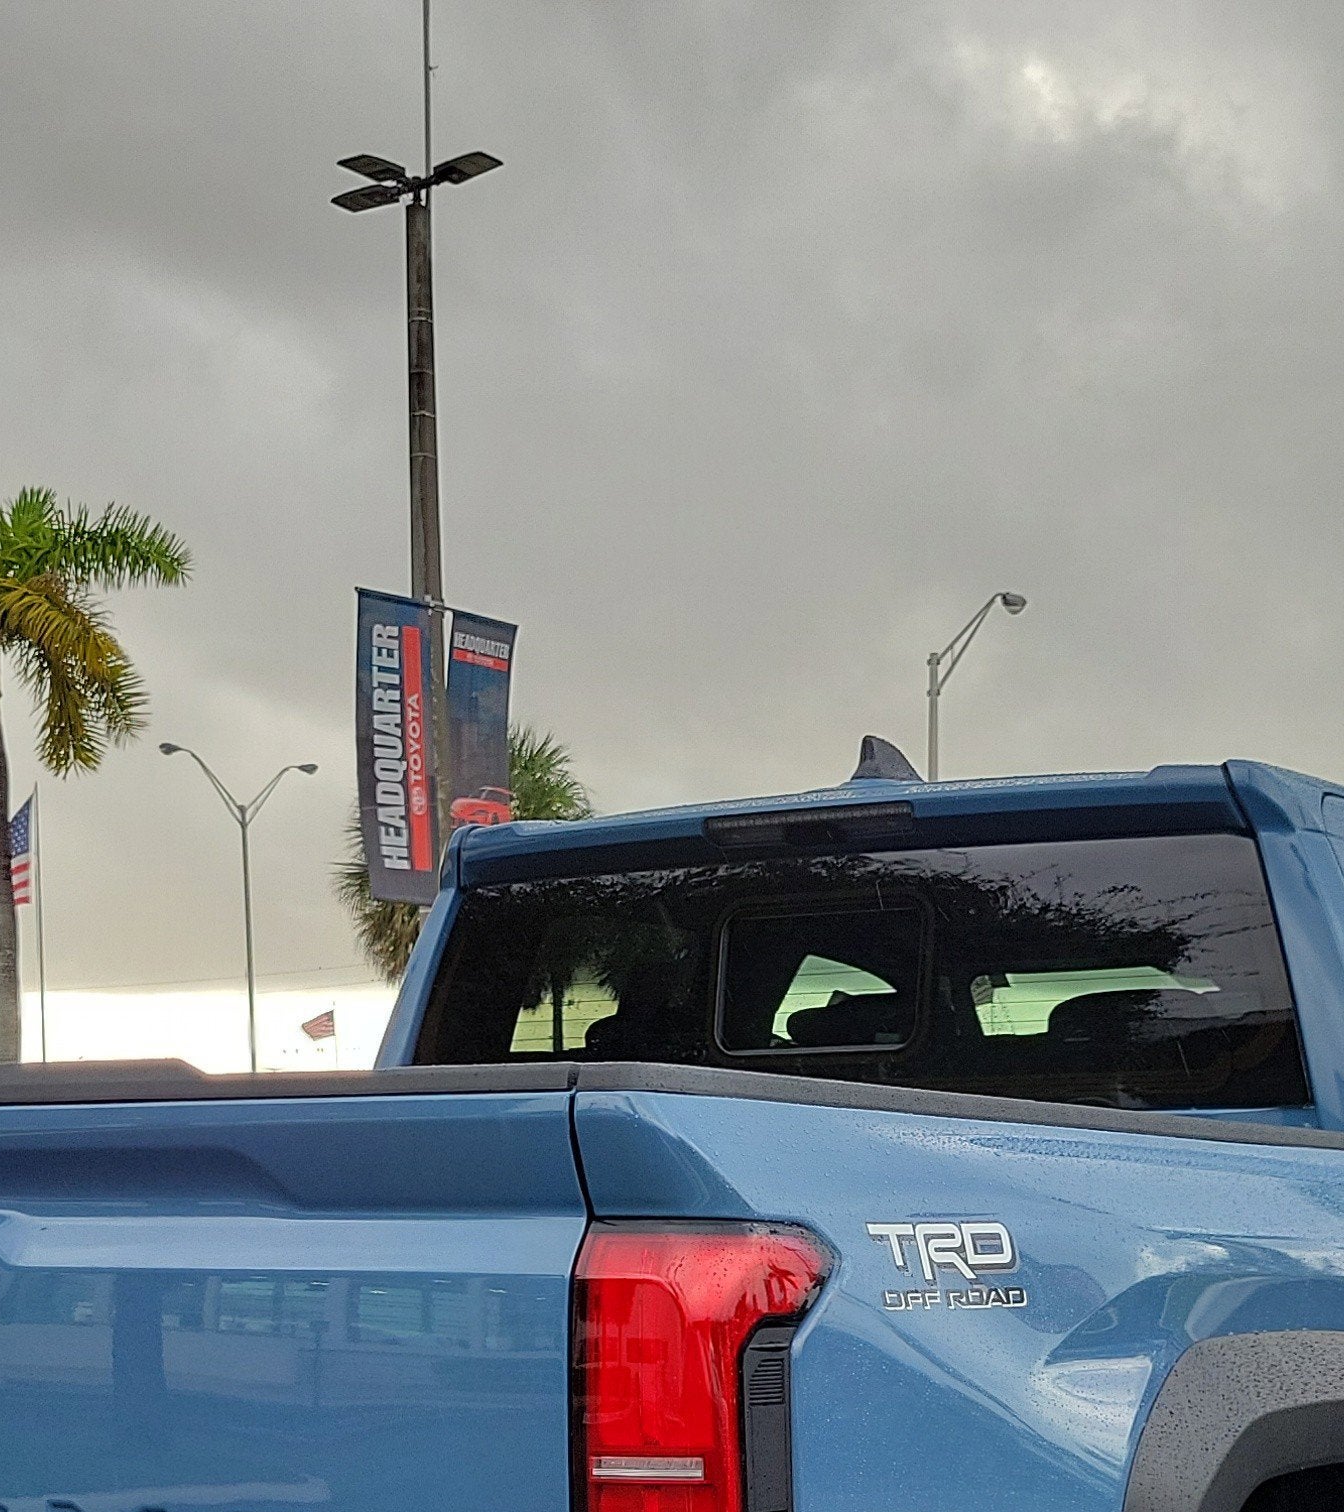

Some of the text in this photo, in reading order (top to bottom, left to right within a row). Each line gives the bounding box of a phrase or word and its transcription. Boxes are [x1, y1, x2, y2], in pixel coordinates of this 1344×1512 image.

[453, 631, 510, 660] HEADQUARTER
[371, 623, 412, 871] HEADQUARTER
[407, 693, 424, 782] TOYOTA
[865, 1221, 1016, 1282] TRD
[883, 1286, 1028, 1311] OFF ROAD
